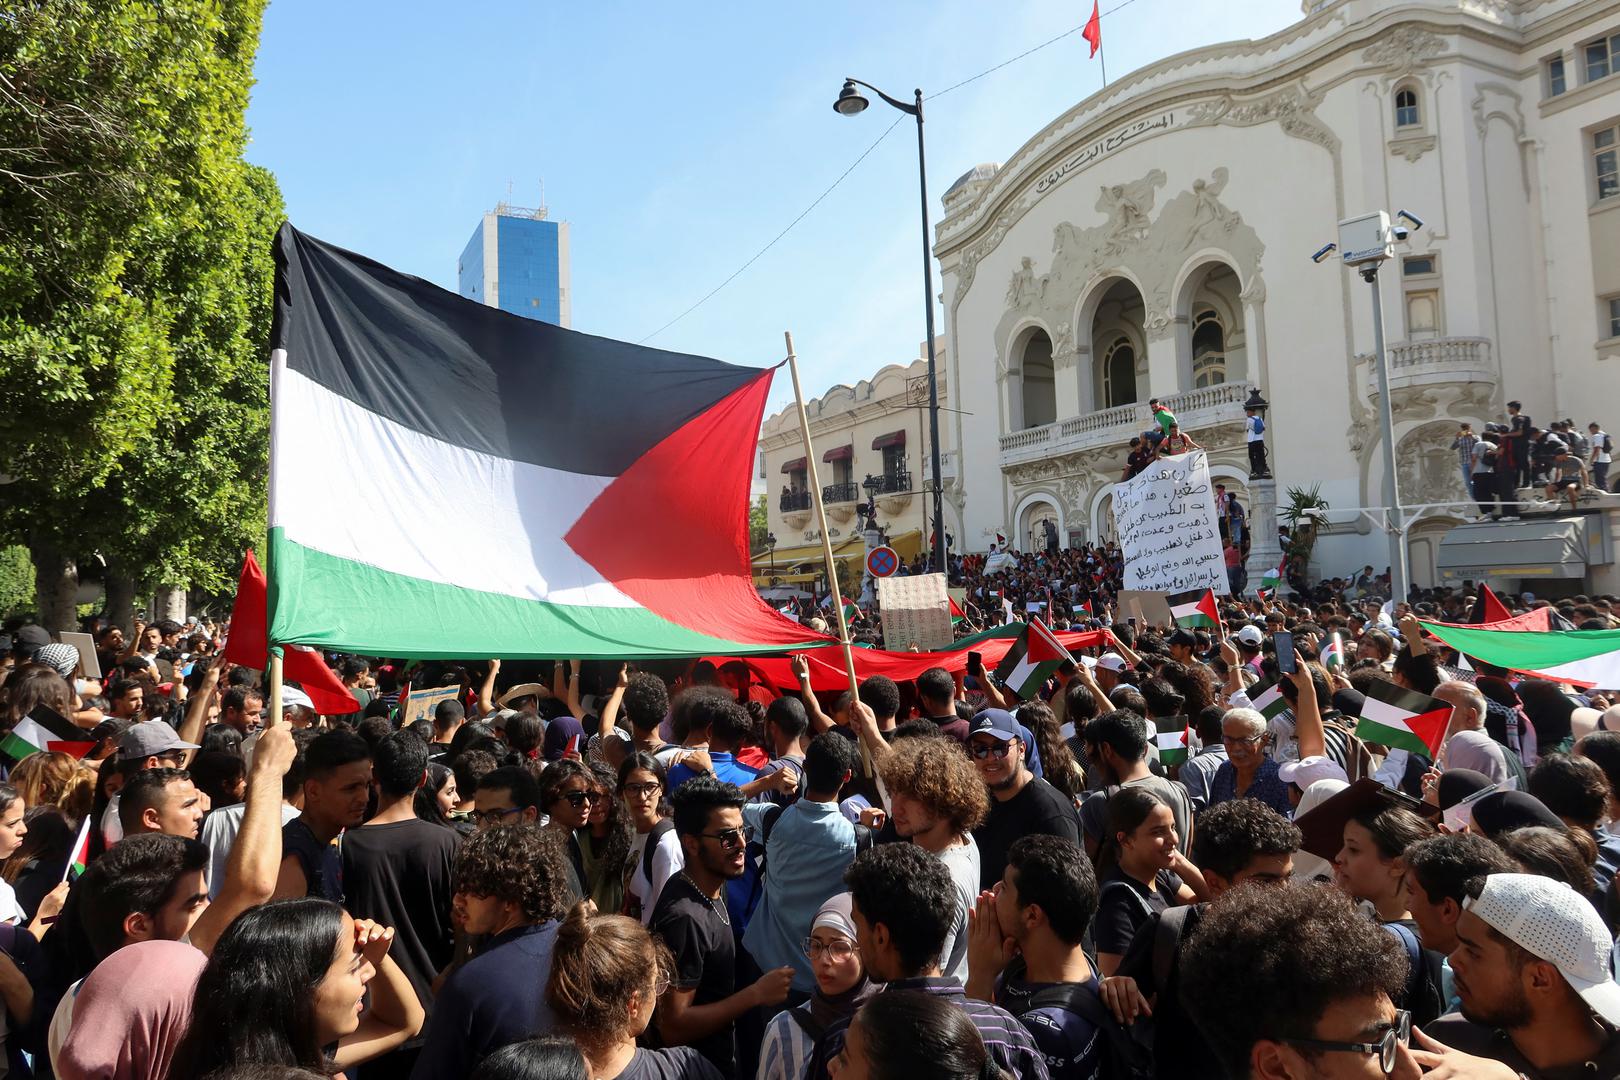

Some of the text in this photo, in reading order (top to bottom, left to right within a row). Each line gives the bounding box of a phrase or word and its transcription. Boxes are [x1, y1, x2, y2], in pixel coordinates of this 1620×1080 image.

[1147, 503, 1186, 521] الطبيب
[1181, 557, 1194, 566] الله
[1195, 553, 1220, 567] حسبي
